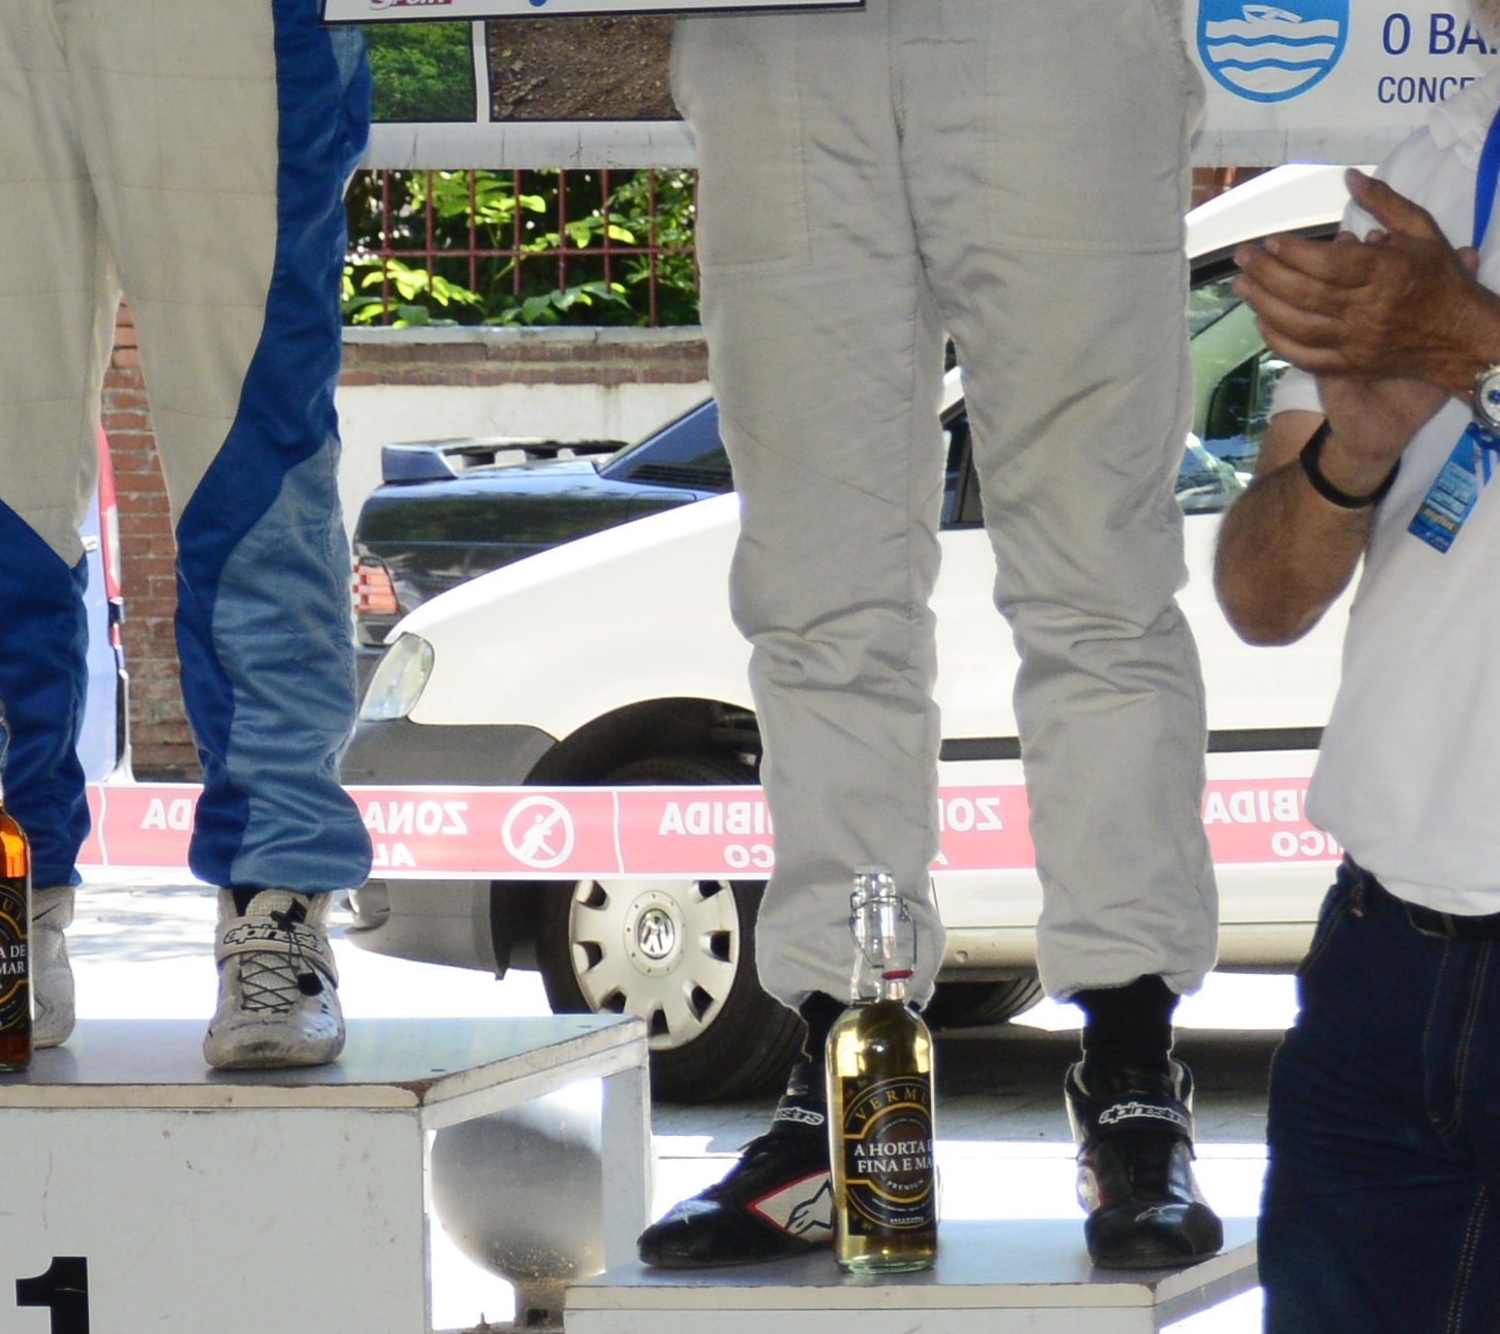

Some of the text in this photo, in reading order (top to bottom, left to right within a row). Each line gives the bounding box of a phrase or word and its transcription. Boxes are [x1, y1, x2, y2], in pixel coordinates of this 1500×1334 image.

[1382, 12, 1412, 55] O
[10, 944, 27, 958] DE
[854, 1087, 930, 1121] VERMU
[854, 1141, 926, 1157] A HORTA
[857, 1157, 934, 1174] FINA E MA
[886, 1178, 925, 1192] PREMIUM
